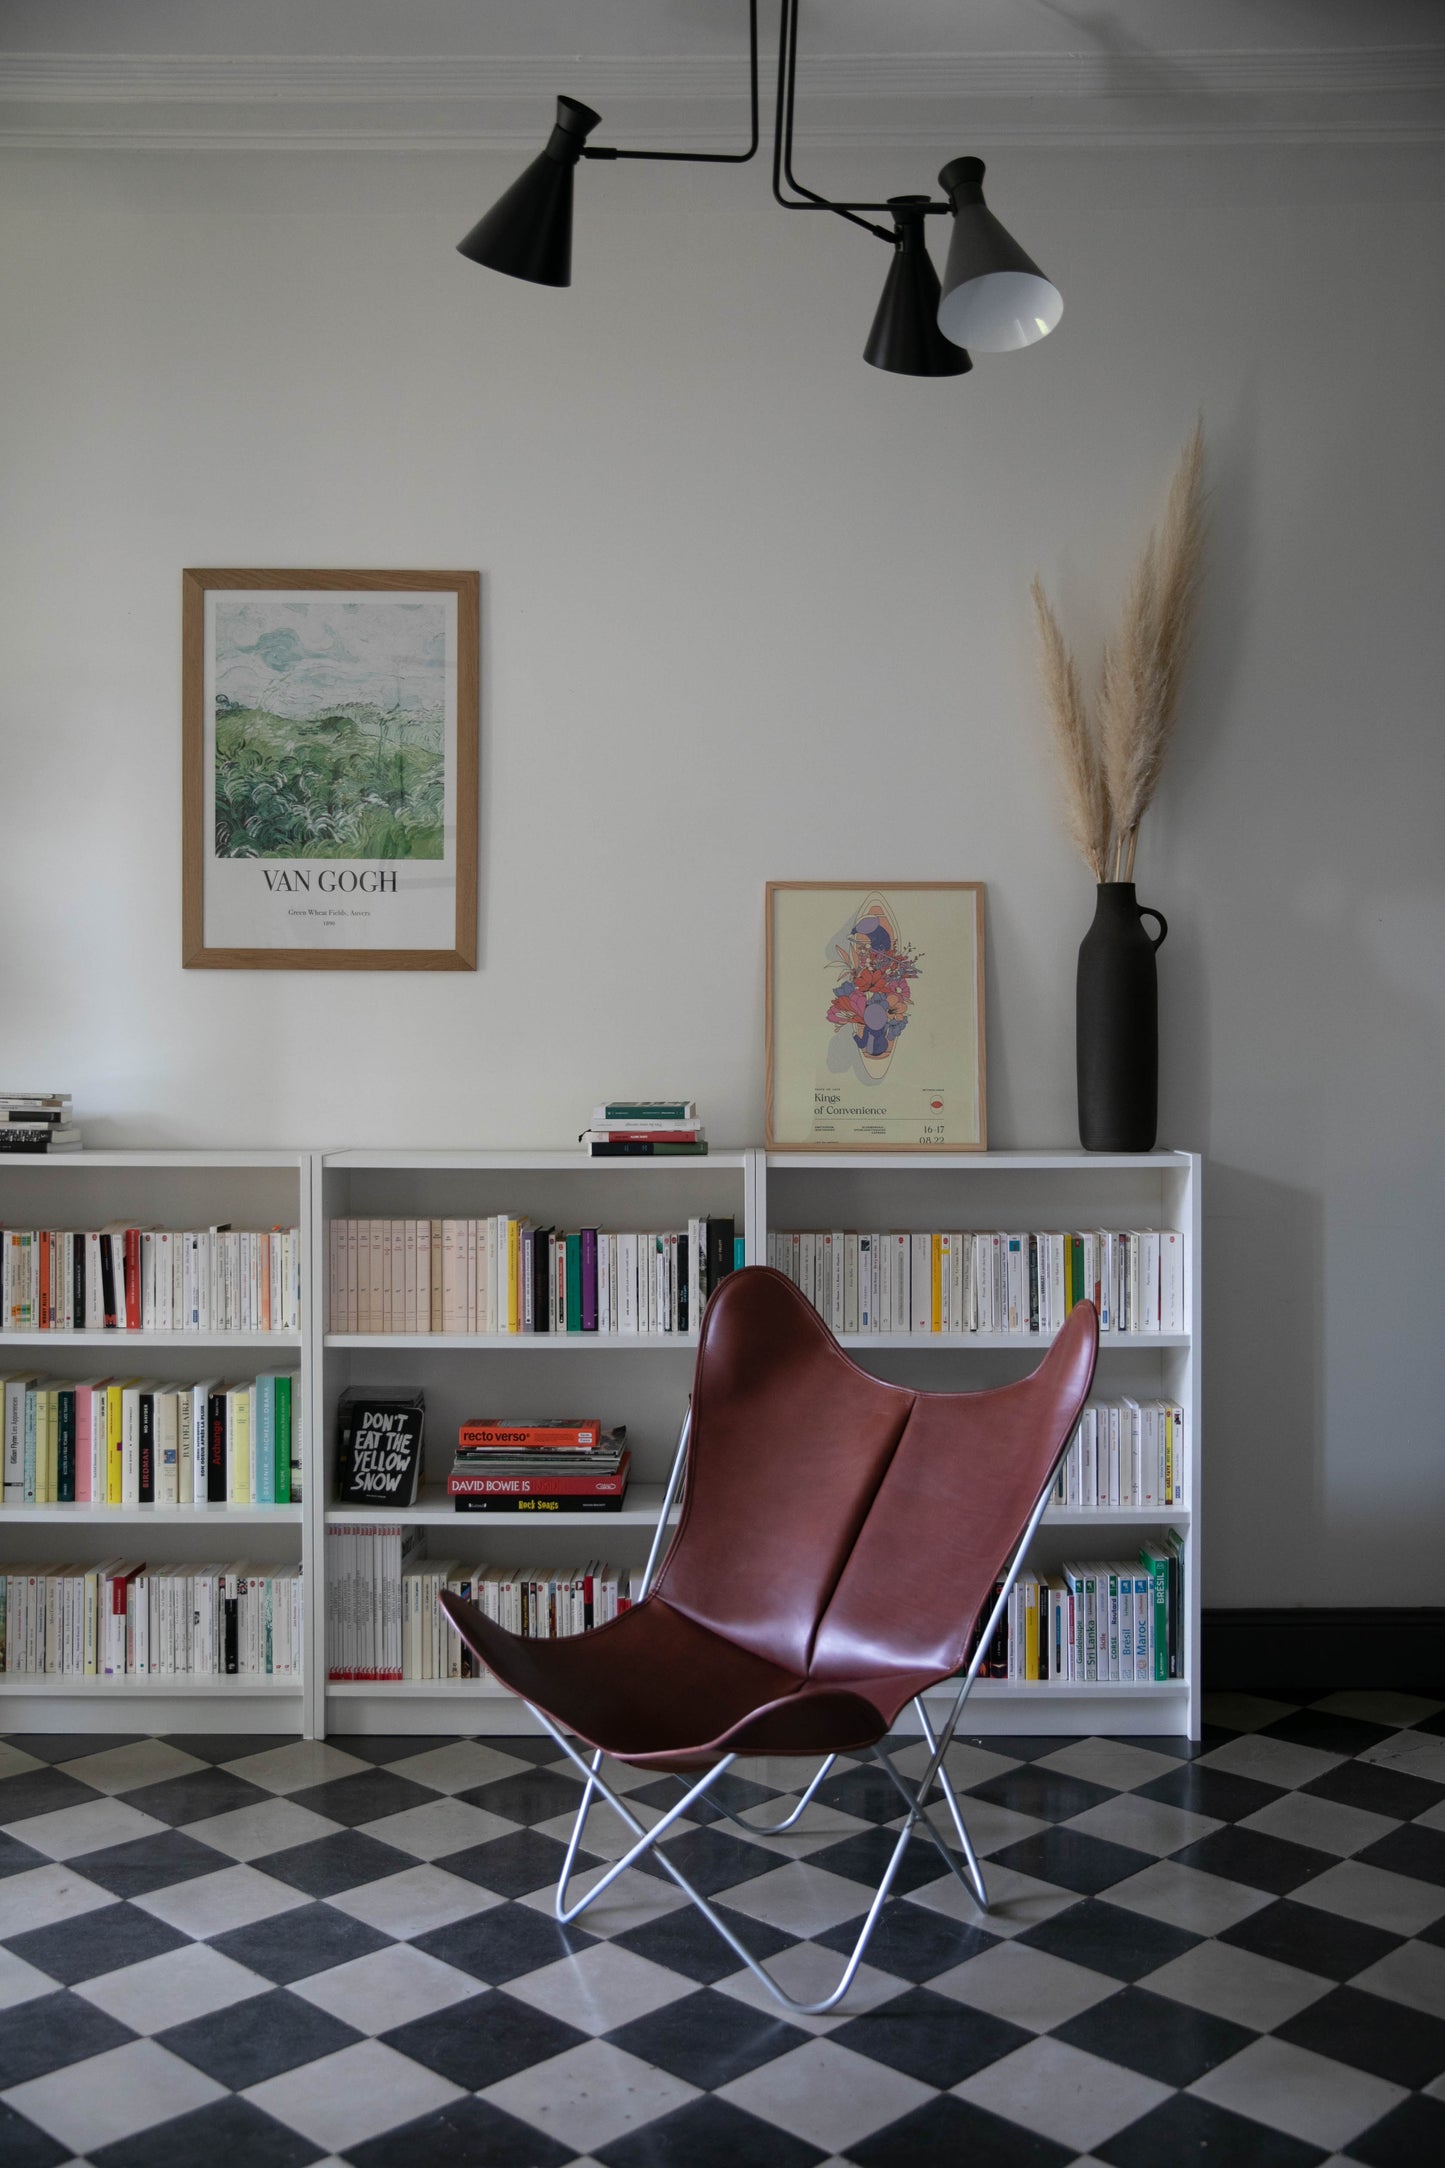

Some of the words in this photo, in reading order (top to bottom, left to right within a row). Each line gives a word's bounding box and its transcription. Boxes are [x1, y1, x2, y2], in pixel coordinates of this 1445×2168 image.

[262, 870, 312, 892] VAN
[318, 870, 398, 893] GOGH
[288, 908, 307, 917] Green
[308, 908, 327, 917] Wheat
[814, 1092, 841, 1105] Kings
[814, 1105, 824, 1116] of
[826, 1105, 887, 1116] Convenience
[10, 1396, 19, 1426] Apparences
[362, 1411, 409, 1432] DON'T
[10, 1426, 18, 1435] Les
[143, 1425, 149, 1434] MO
[182, 1399, 190, 1458] BAUDELAIRE
[463, 1431, 494, 1442] recto
[10, 1435, 19, 1449] Flynn
[213, 1420, 223, 1465] Archange
[355, 1430, 383, 1450] EAT
[386, 1432, 413, 1454] THE
[10, 1449, 18, 1465] Gillian
[353, 1449, 411, 1472] YELLOW
[142, 1448, 150, 1488] BIRDMAN
[350, 1472, 402, 1491] SNOW
[452, 1480, 484, 1491] DAVID
[486, 1480, 519, 1491] BOWIE
[522, 1480, 530, 1491] IS
[518, 1499, 535, 1510] Rock
[537, 1499, 559, 1510] Songs
[1155, 1572, 1165, 1604] BRÉSIL
[1075, 1620, 1084, 1665] Guadeloupe
[1086, 1620, 1095, 1651] Lanka
[1122, 1629, 1131, 1656] Brésil
[1136, 1620, 1146, 1656] Maroc
[1086, 1653, 1095, 1666] Sri
